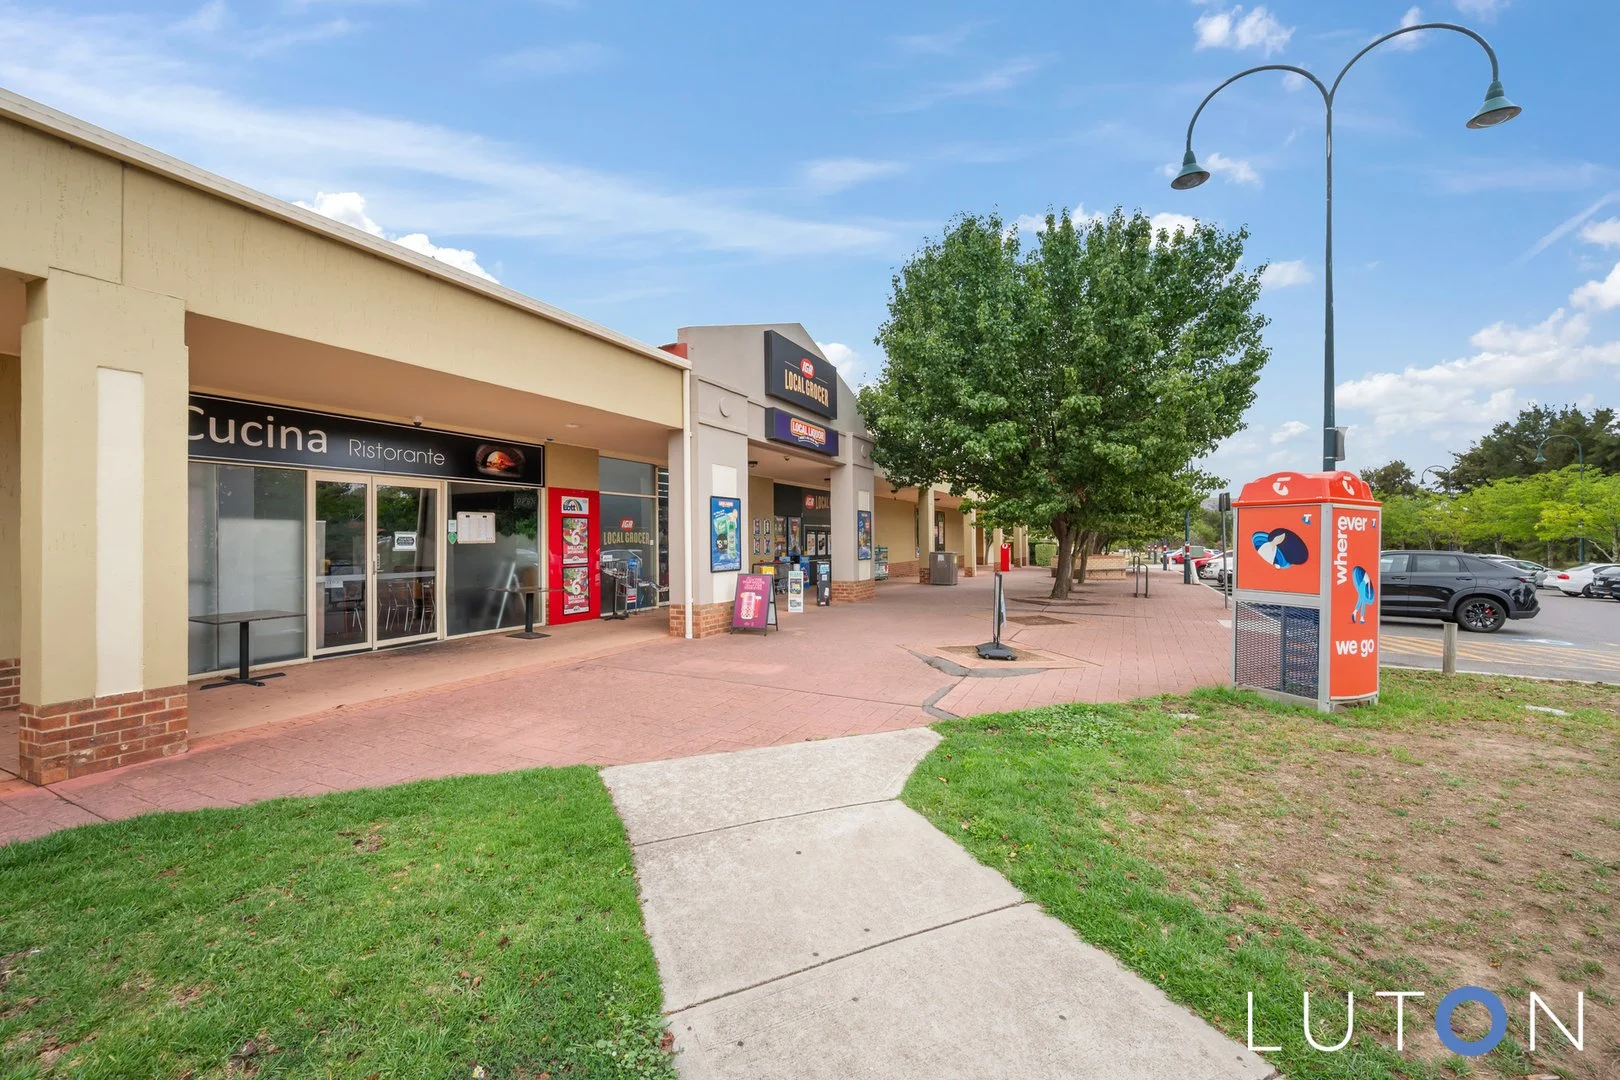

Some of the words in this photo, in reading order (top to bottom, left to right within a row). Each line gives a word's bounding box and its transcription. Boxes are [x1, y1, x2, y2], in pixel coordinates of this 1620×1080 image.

[784, 368, 805, 394] LOCAL
[805, 379, 829, 407] GROCER
[188, 405, 327, 454] Cucina
[792, 421, 808, 435] LOCAL
[808, 426, 825, 441] LIQUOR
[349, 438, 445, 466] Ristorante
[1338, 515, 1368, 531] ever
[603, 531, 624, 545] LOCAL
[625, 531, 650, 545] GROCER
[1334, 530, 1348, 585] wher
[1335, 639, 1358, 655] we
[1360, 638, 1375, 658] go
